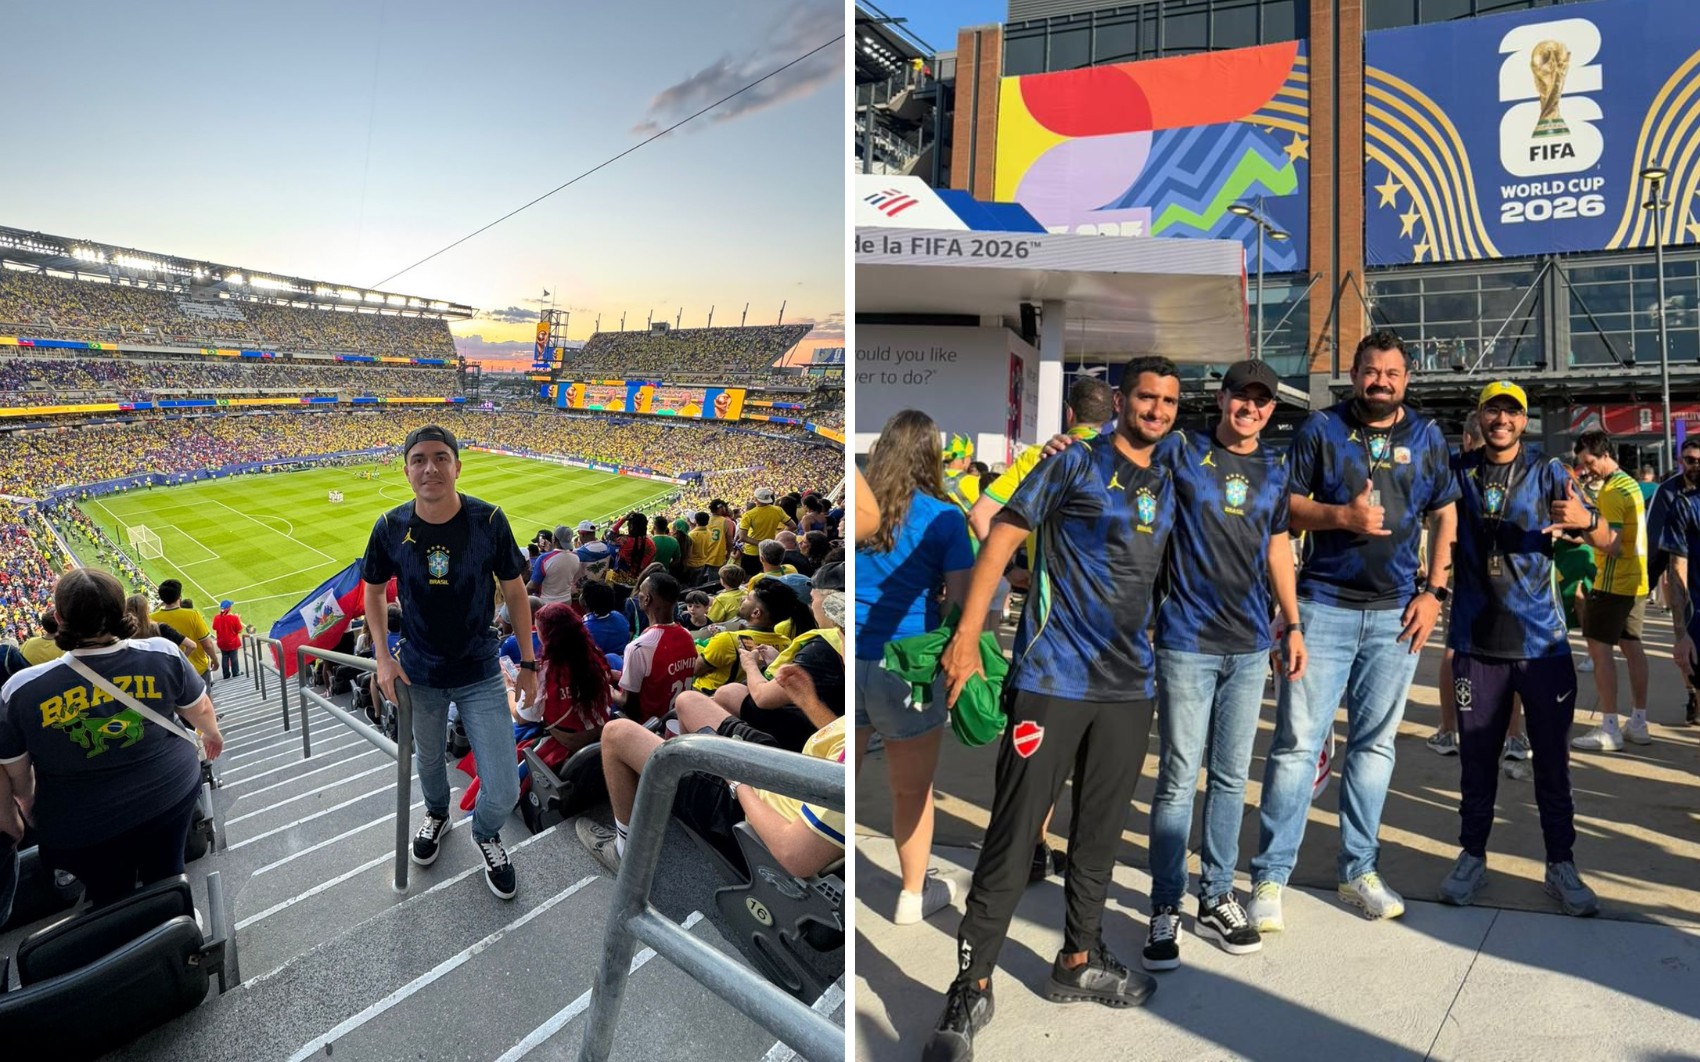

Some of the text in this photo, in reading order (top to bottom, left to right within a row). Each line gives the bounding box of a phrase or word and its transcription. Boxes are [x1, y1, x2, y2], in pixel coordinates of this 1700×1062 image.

[1529, 142, 1575, 162] FIFA
[1500, 176, 1605, 199] WORLD CUP
[1500, 194, 1606, 224] 2026
[883, 235, 902, 254] la
[911, 237, 963, 257] FIFA
[855, 346, 958, 366] ould you like
[880, 370, 898, 385] to
[40, 675, 163, 729] BRAZIL
[749, 899, 768, 921] 16
